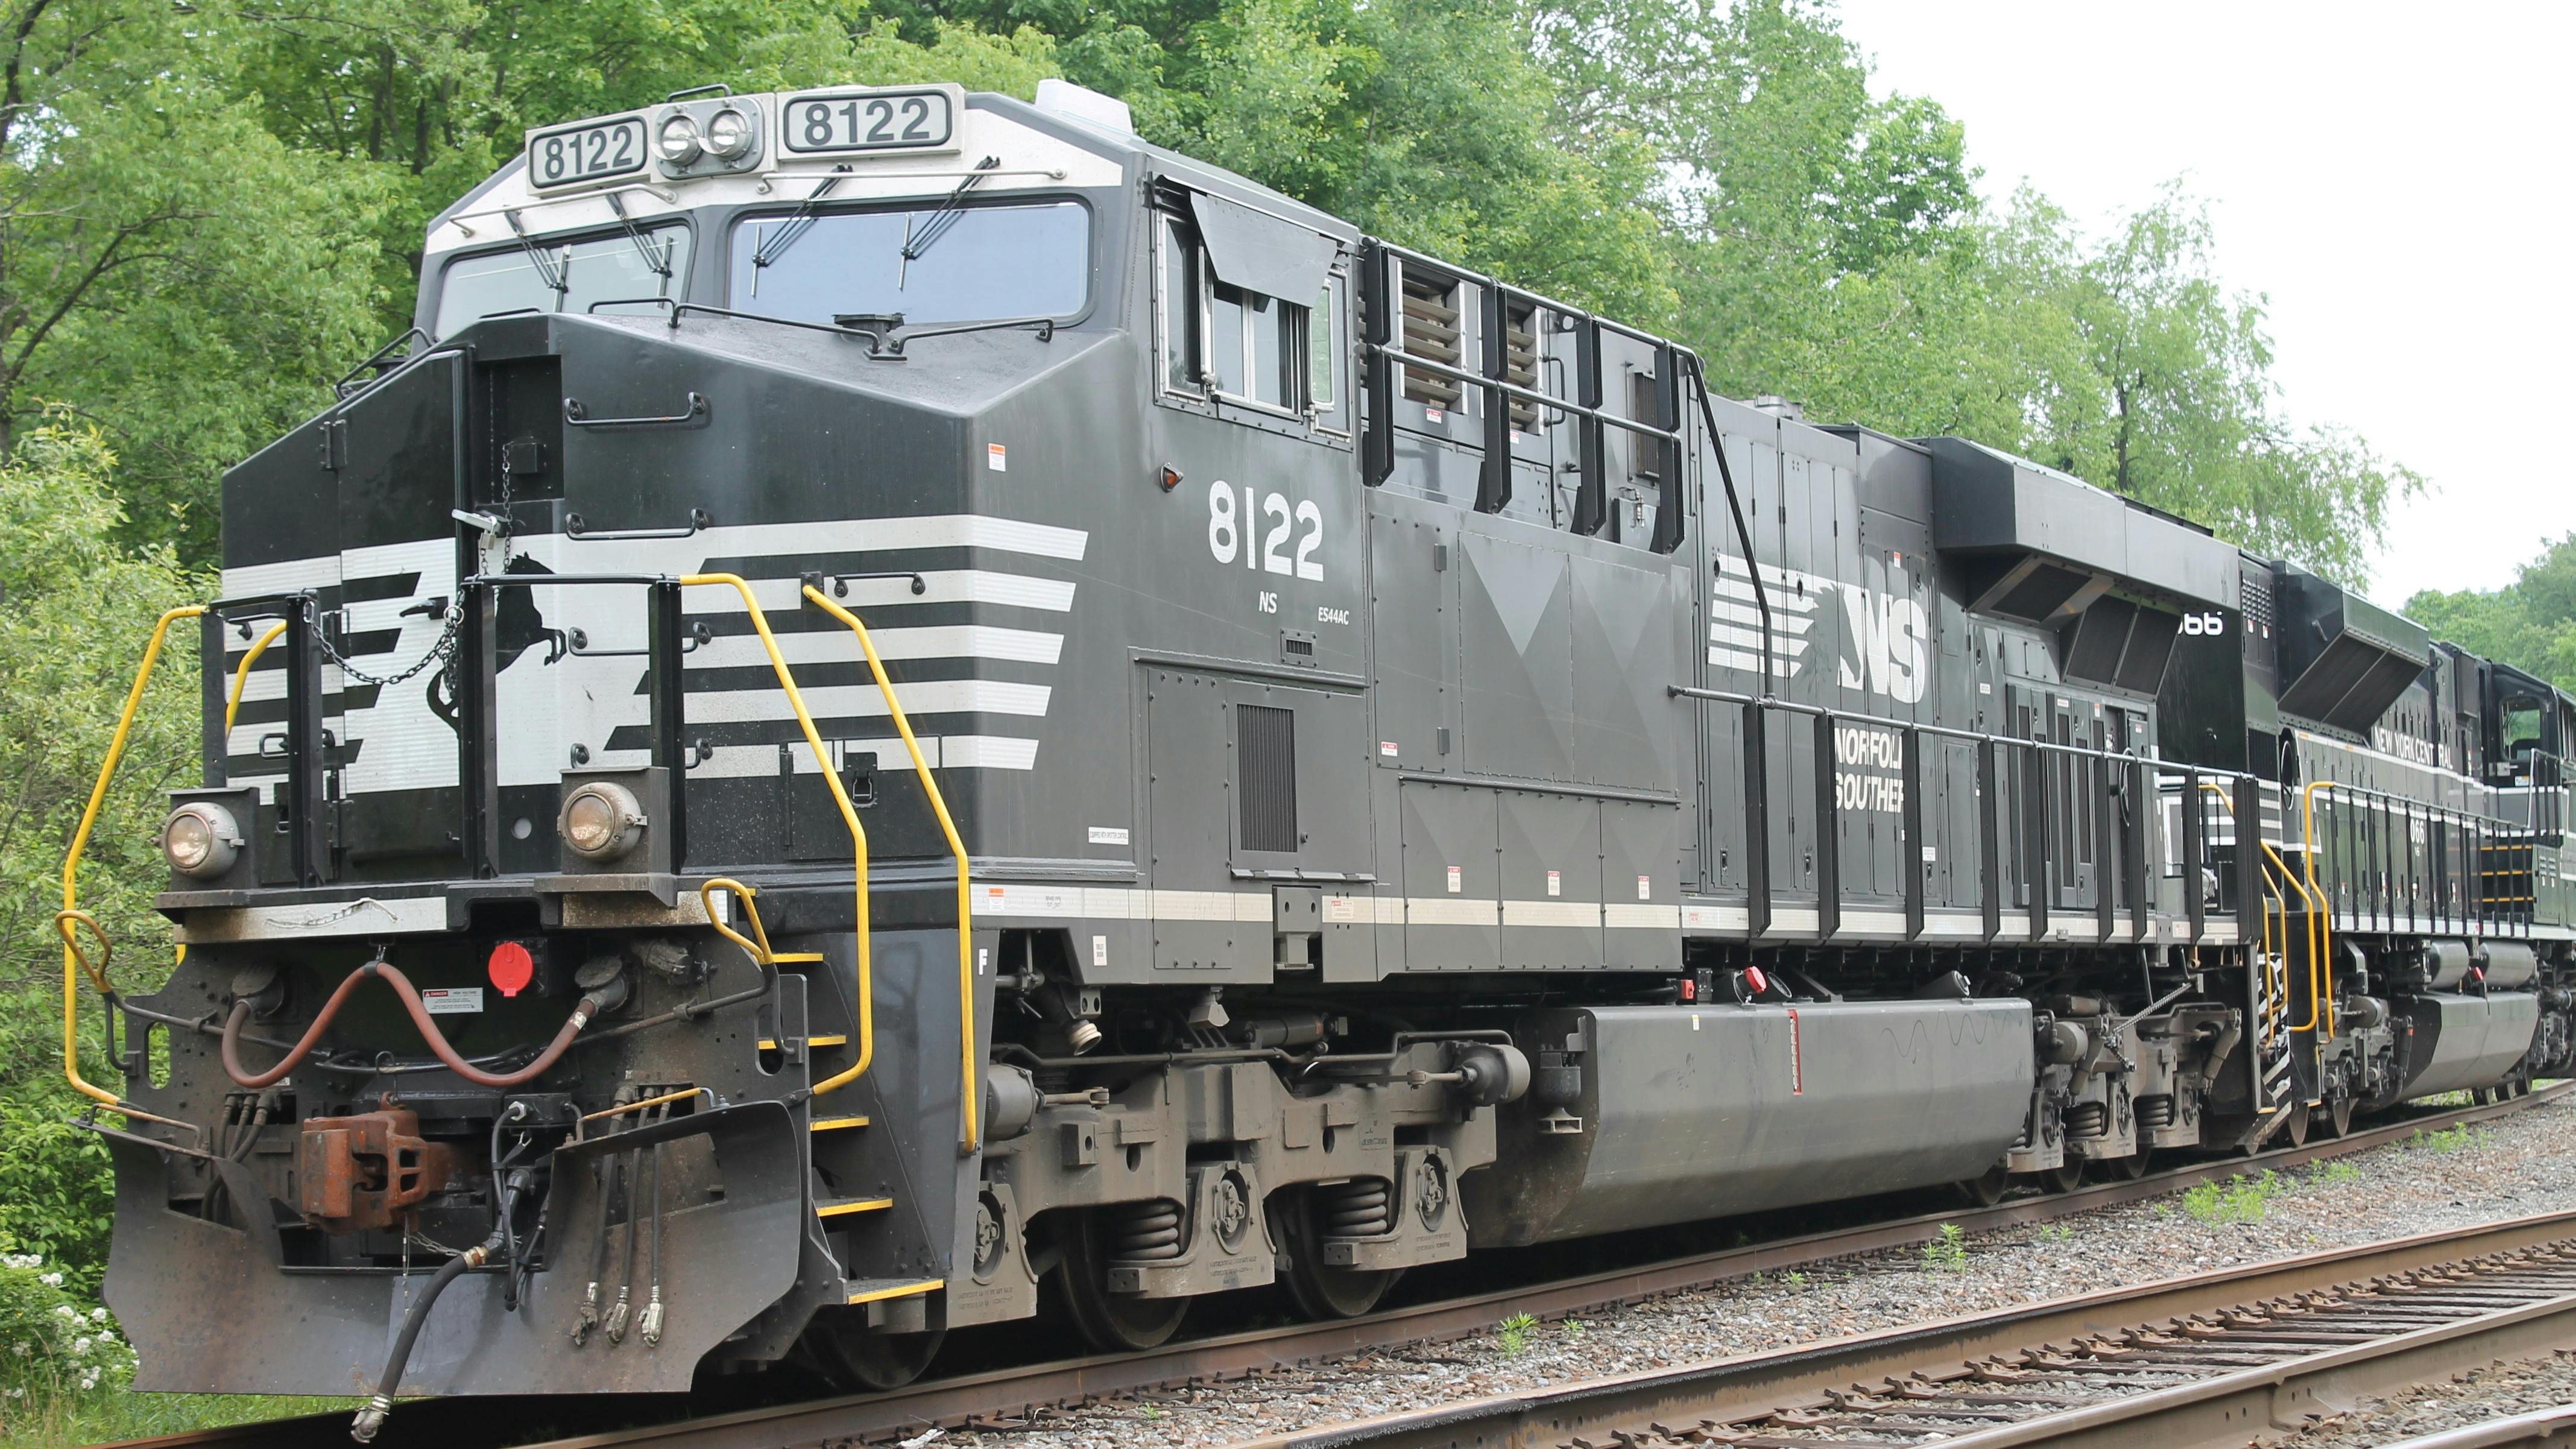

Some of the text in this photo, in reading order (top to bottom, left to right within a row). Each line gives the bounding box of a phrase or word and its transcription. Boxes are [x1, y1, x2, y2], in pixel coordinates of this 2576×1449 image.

[804, 98, 930, 146] 8122
[545, 125, 633, 179] 8122
[1209, 480, 1324, 582] 8122
[1258, 590, 1278, 614] NS
[1318, 606, 1350, 625] ES44AC
[2177, 611, 2223, 636] 66
[2375, 725, 2393, 754] NEW
[2394, 731, 2414, 761] YORK
[979, 949, 988, 975] F
